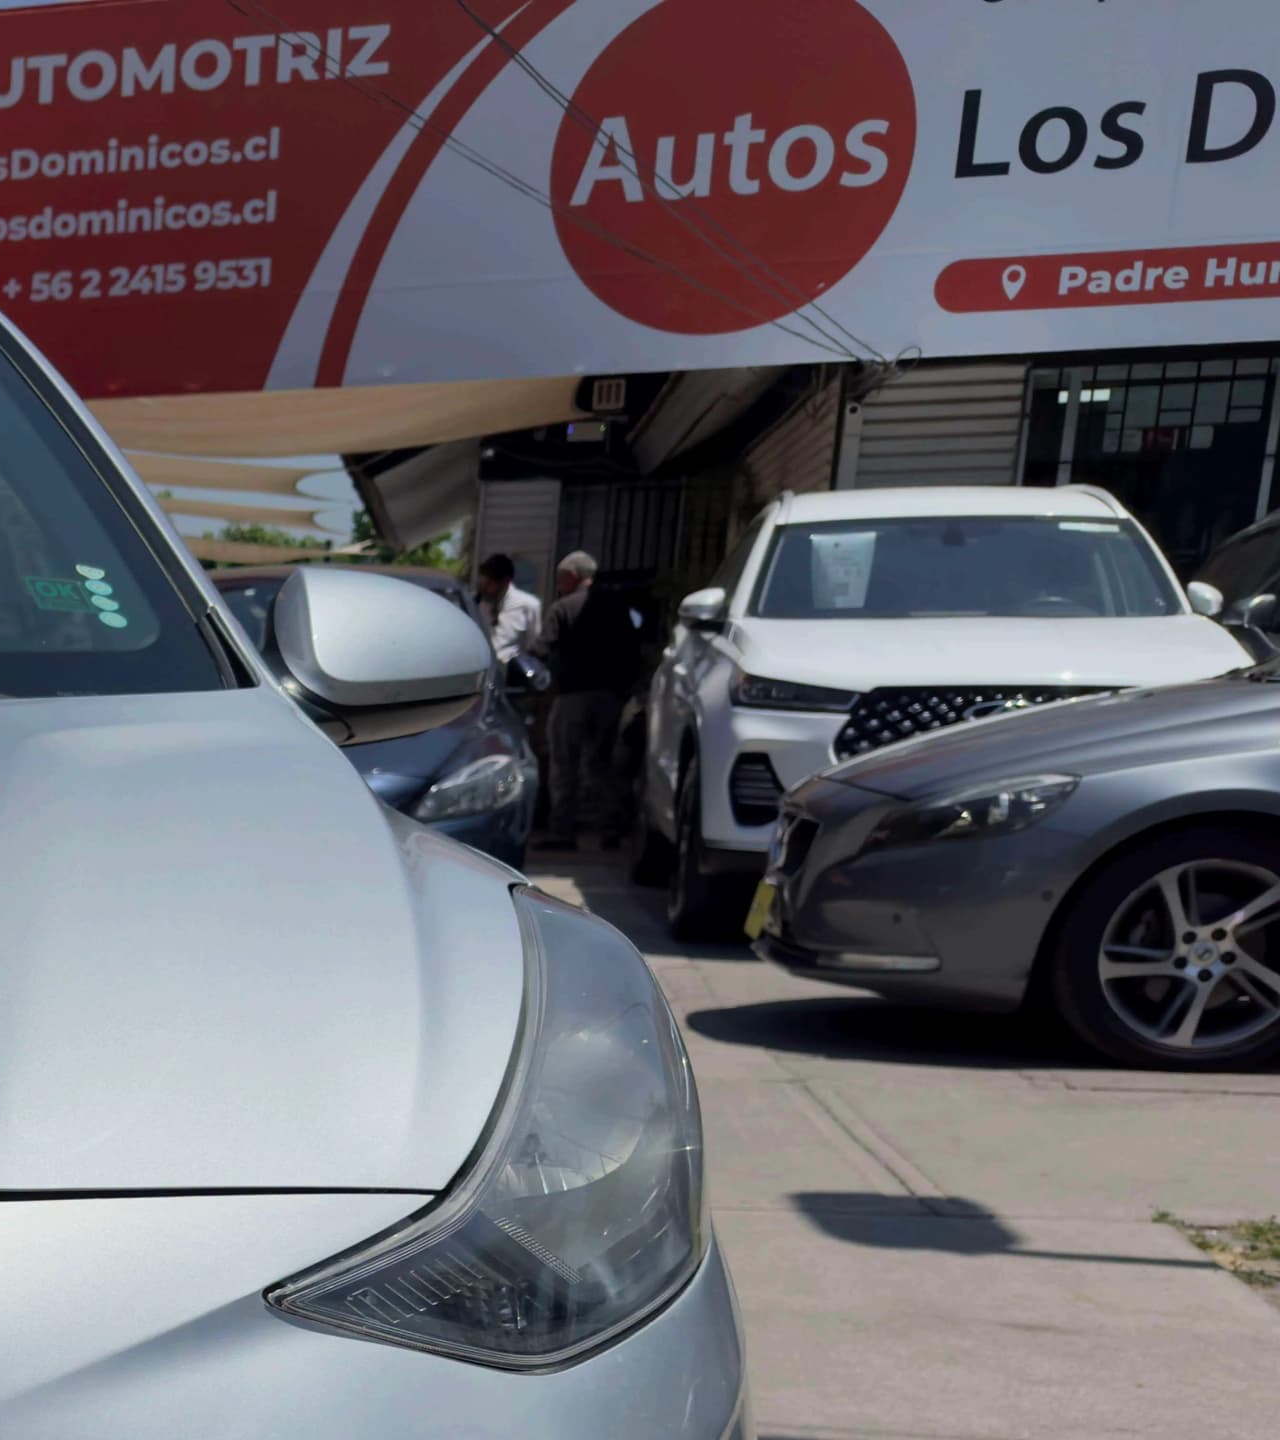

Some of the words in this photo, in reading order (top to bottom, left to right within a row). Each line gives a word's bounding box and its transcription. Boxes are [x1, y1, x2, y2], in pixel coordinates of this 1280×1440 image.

[568, 112, 890, 207] Autos
[954, 88, 1147, 179] Los
[30, 271, 73, 302] 56
[79, 268, 102, 299] 2
[108, 263, 187, 297] 2415
[193, 257, 273, 291] 9531
[1057, 260, 1190, 296] Padre
